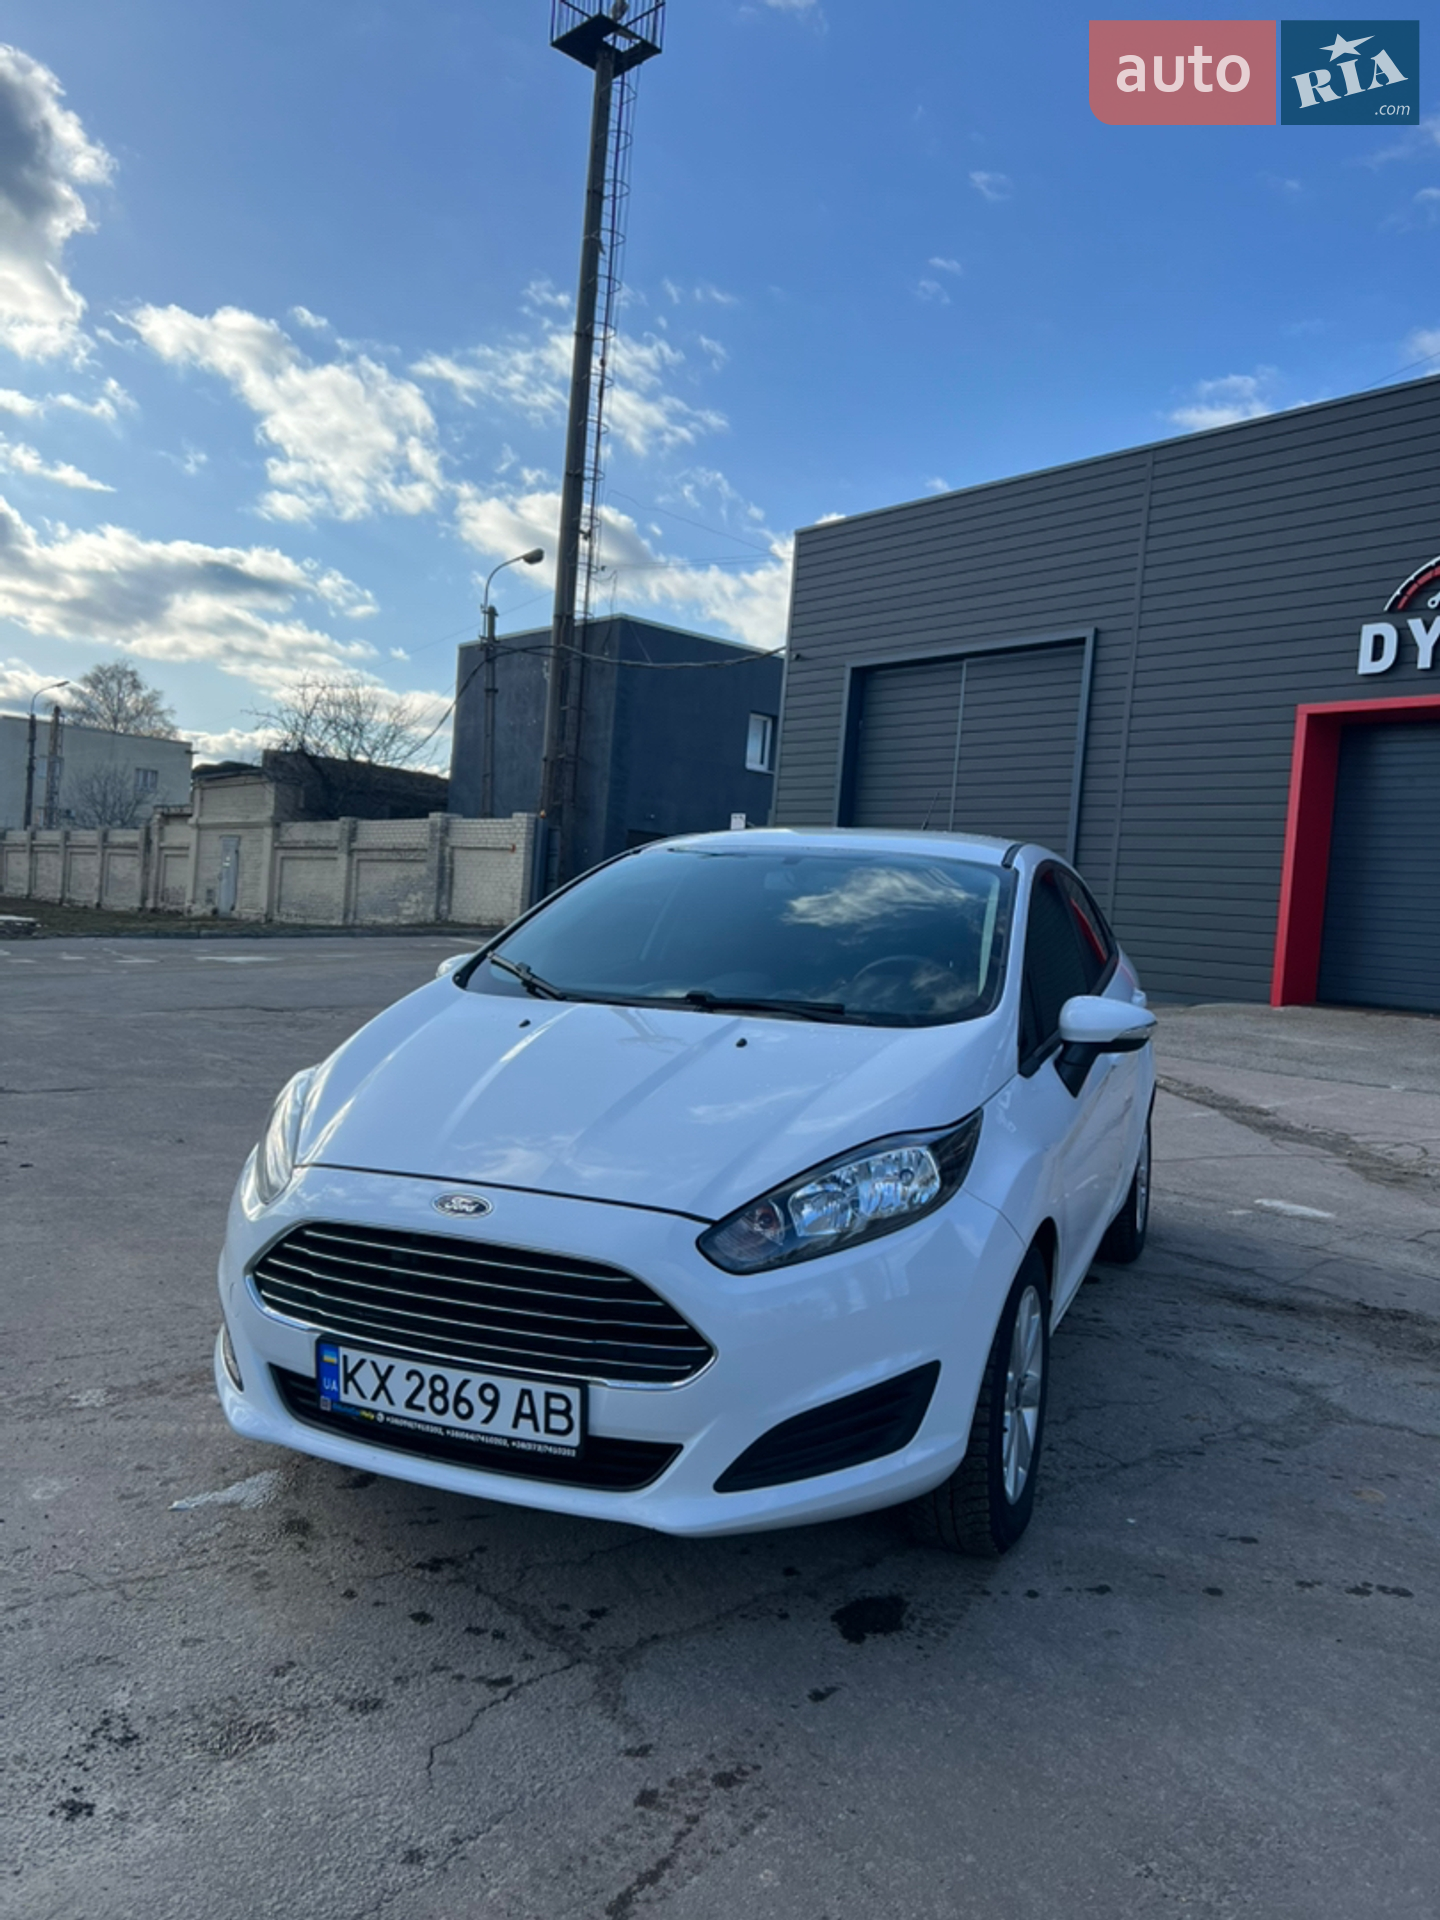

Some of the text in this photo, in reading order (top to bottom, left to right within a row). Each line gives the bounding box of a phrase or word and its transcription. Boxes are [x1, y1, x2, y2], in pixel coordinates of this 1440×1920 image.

[323, 1377, 338, 1391] UA
[342, 1354, 395, 1406] KX
[404, 1369, 500, 1424] 2869
[511, 1388, 575, 1437] AB
